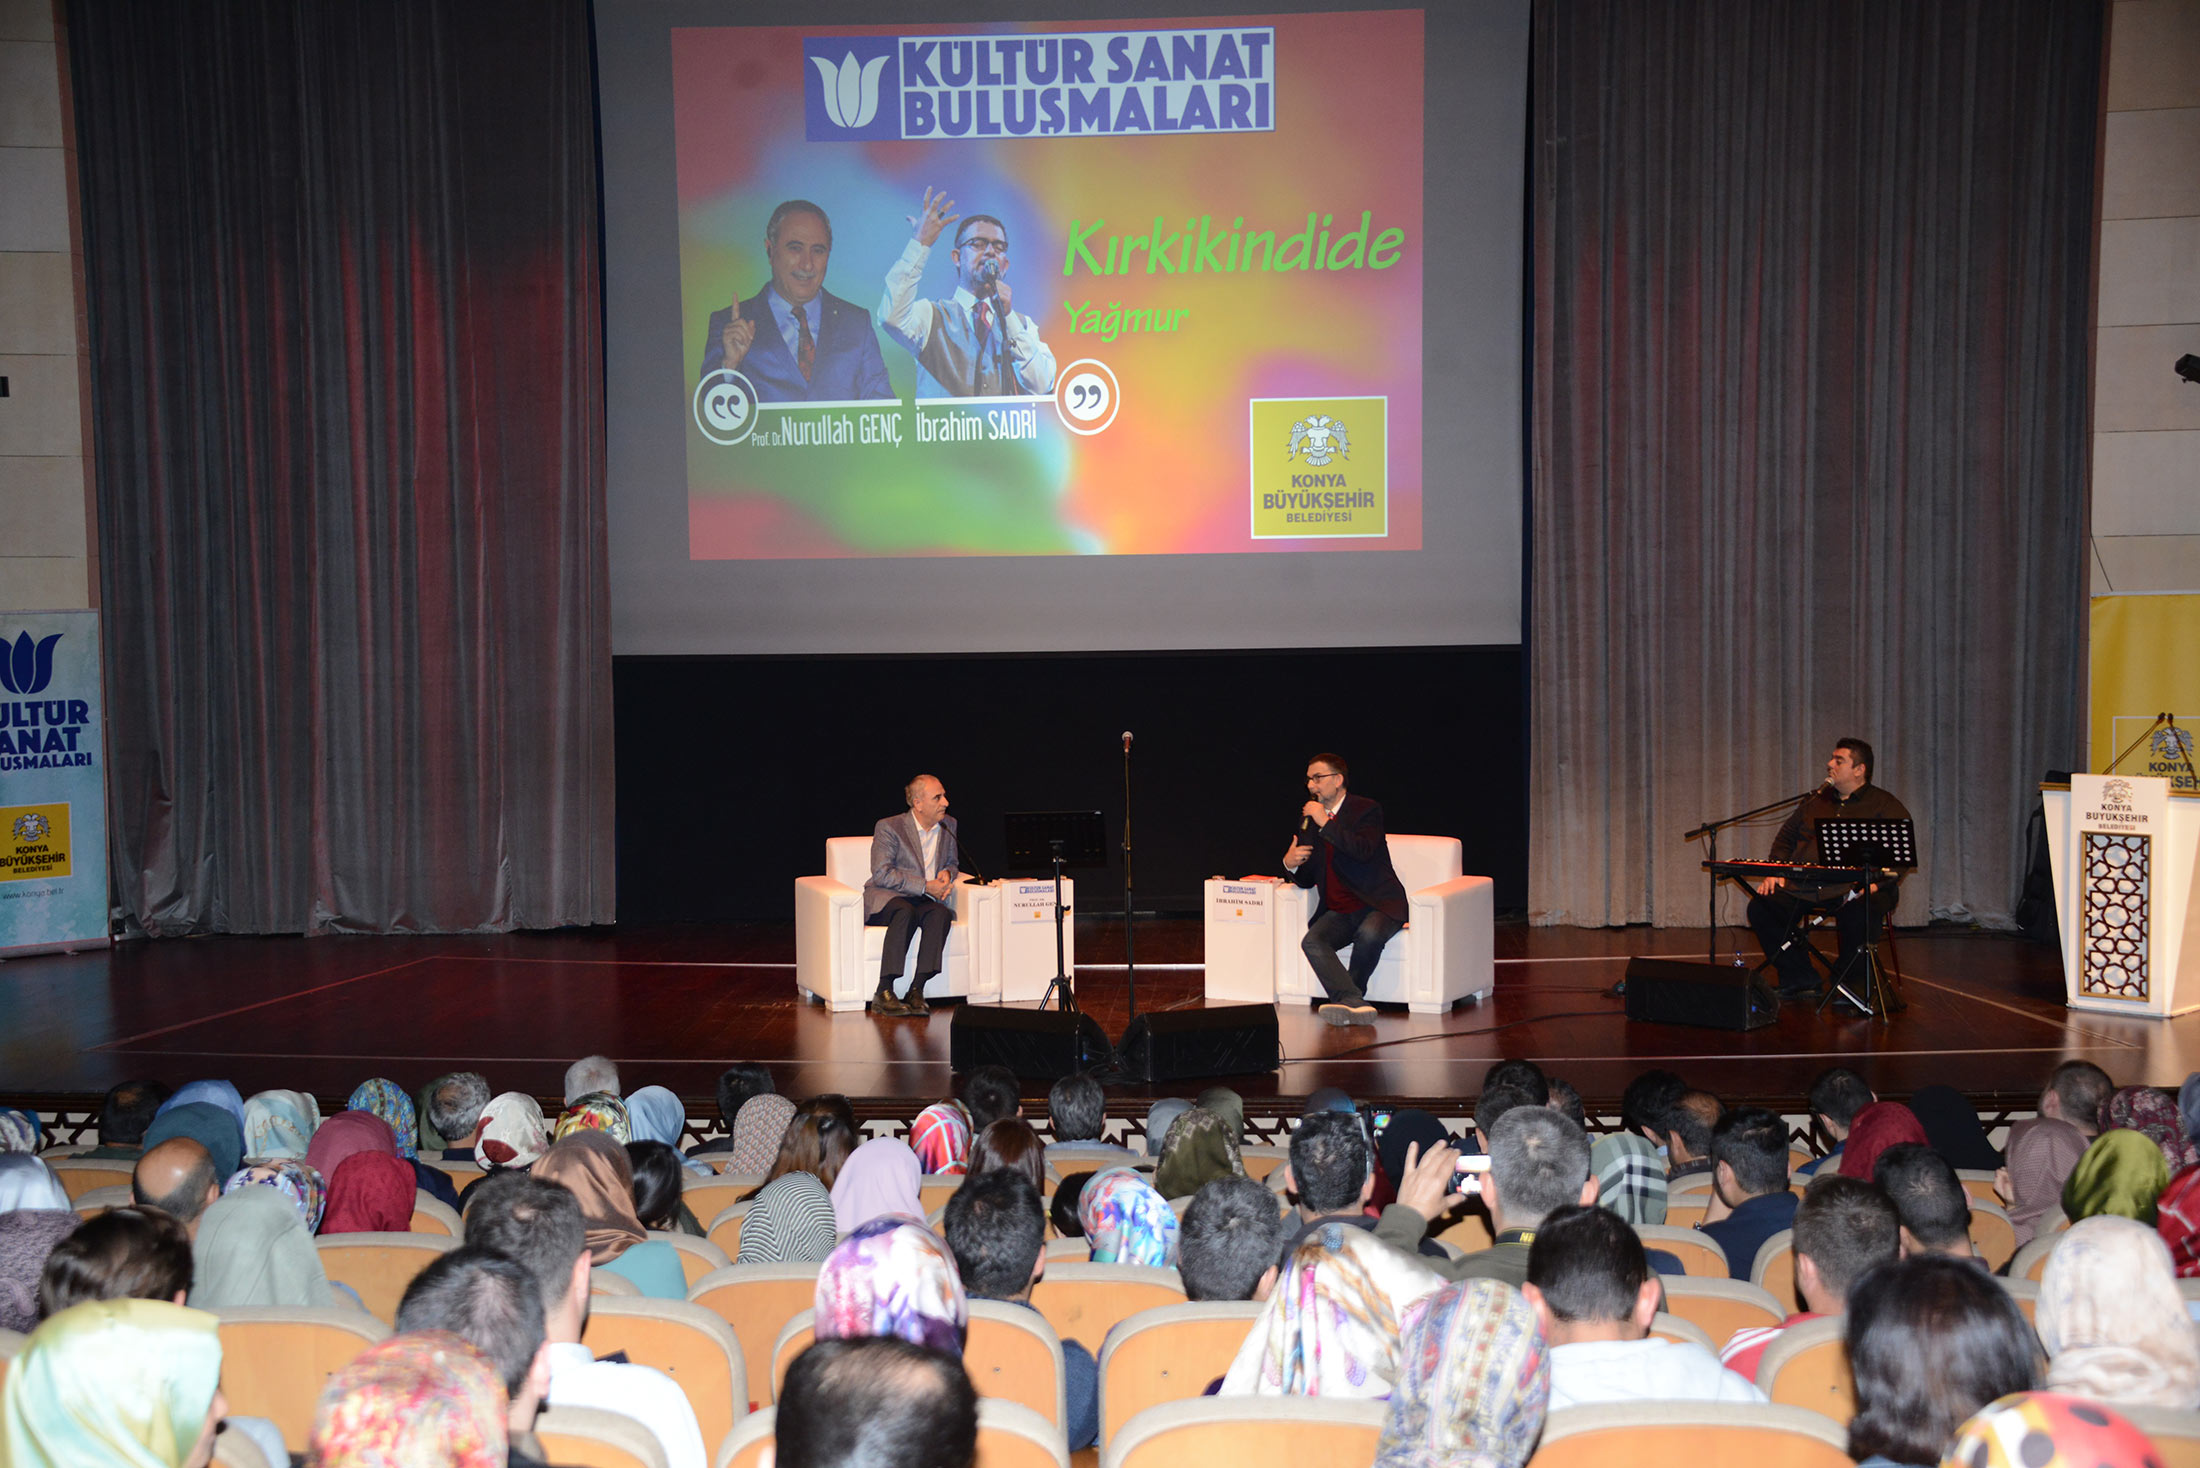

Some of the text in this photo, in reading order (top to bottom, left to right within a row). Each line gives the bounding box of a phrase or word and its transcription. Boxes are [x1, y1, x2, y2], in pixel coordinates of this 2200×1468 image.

[902, 32, 1271, 88] KÜLTÜR SANAT
[903, 82, 1271, 137] BULUŞMALARI
[1063, 210, 1405, 276] Kırkikindide
[1063, 300, 1190, 343] Yağmur
[751, 432, 771, 446] Prof.
[781, 414, 854, 446] Nurullah
[860, 412, 903, 448] GENÇ
[916, 402, 1037, 442] İbrahim SADRİ
[1291, 474, 1347, 488] KONYA
[1263, 488, 1375, 511] BÜYÜKŞEHİR
[1286, 511, 1352, 523] BELEDİYESİ
[0, 699, 90, 729] LTÜR
[0, 727, 81, 755] ANAT
[0, 752, 92, 771] UŞMALARI
[2101, 803, 2132, 812] KONYA
[16, 844, 49, 854] KONYA
